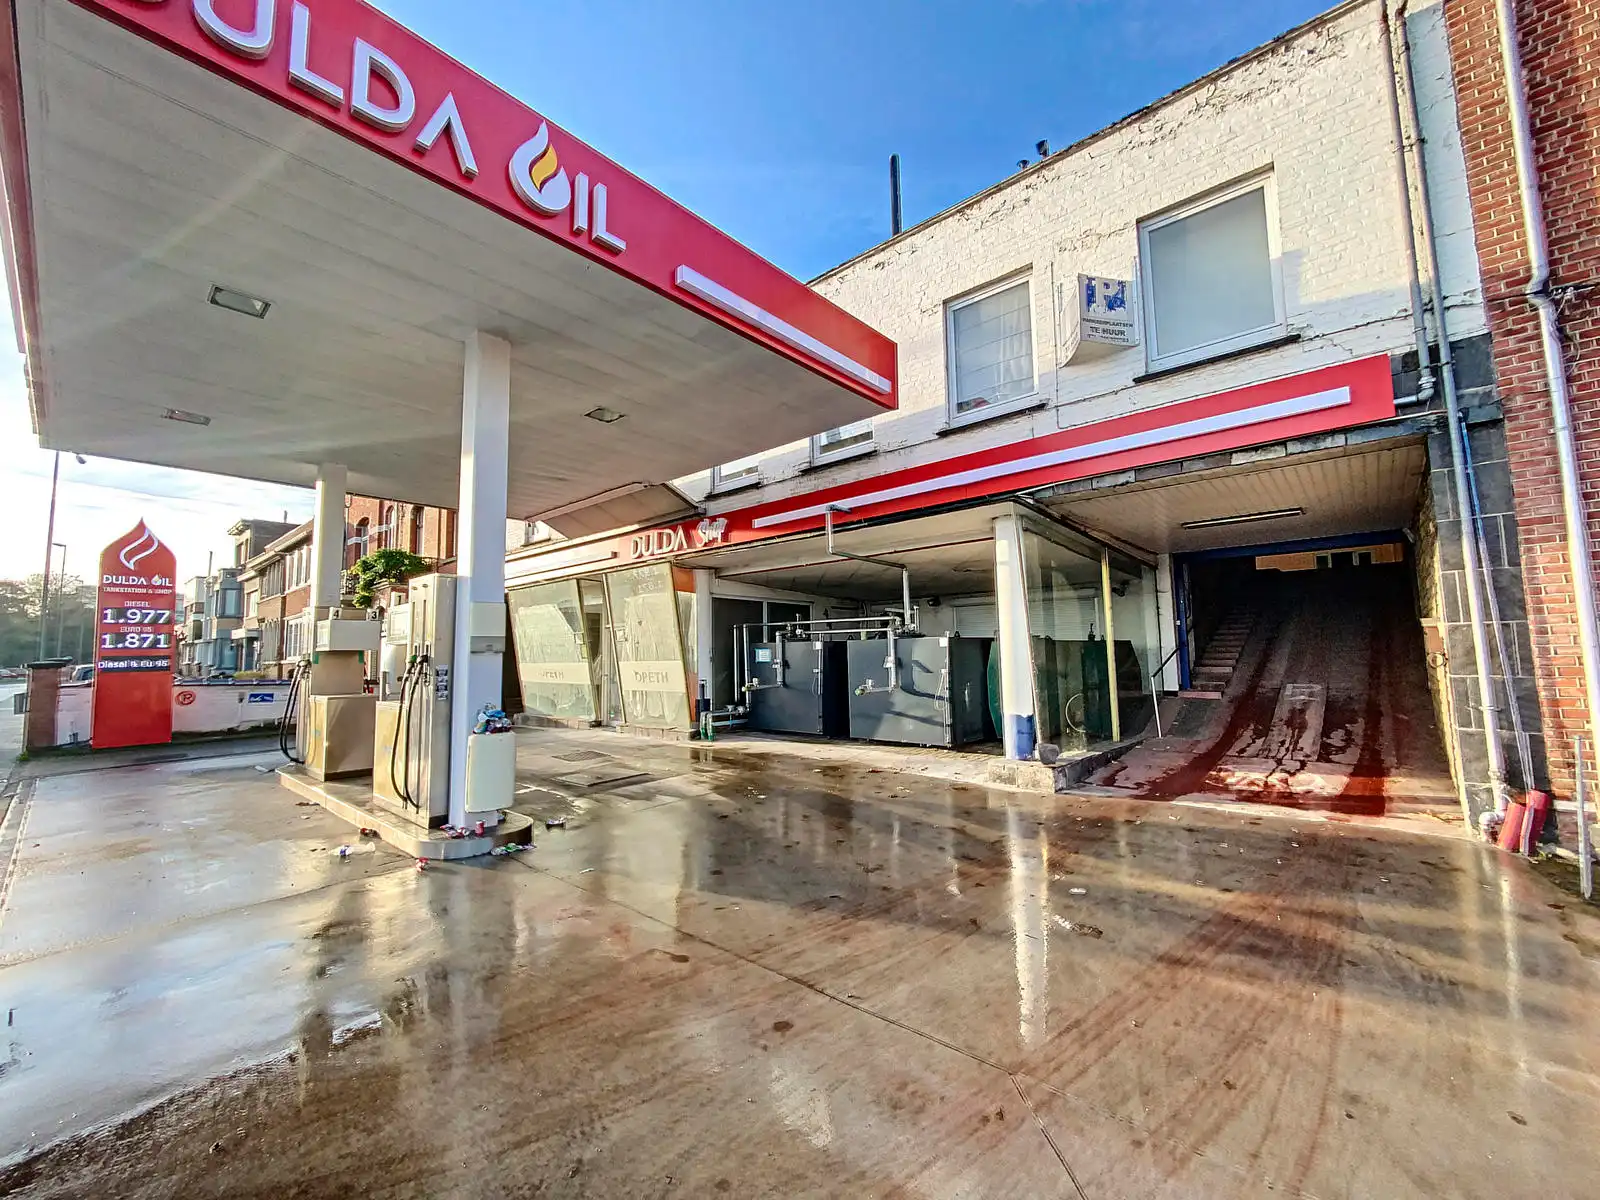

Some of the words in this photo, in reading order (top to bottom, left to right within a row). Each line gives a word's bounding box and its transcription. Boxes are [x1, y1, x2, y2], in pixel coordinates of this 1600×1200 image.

[134, 0, 479, 179] ULDA
[1089, 326, 1101, 334] TE
[1102, 328, 1126, 337] HUUR
[630, 524, 688, 559] DULDA
[103, 574, 147, 585] DULDA
[124, 600, 151, 608] DIESEL
[103, 608, 170, 624] 1.977
[333, 610, 340, 619] 4
[371, 611, 377, 619] 3
[101, 632, 171, 648] 1.871
[97, 660, 128, 669] Diesel
